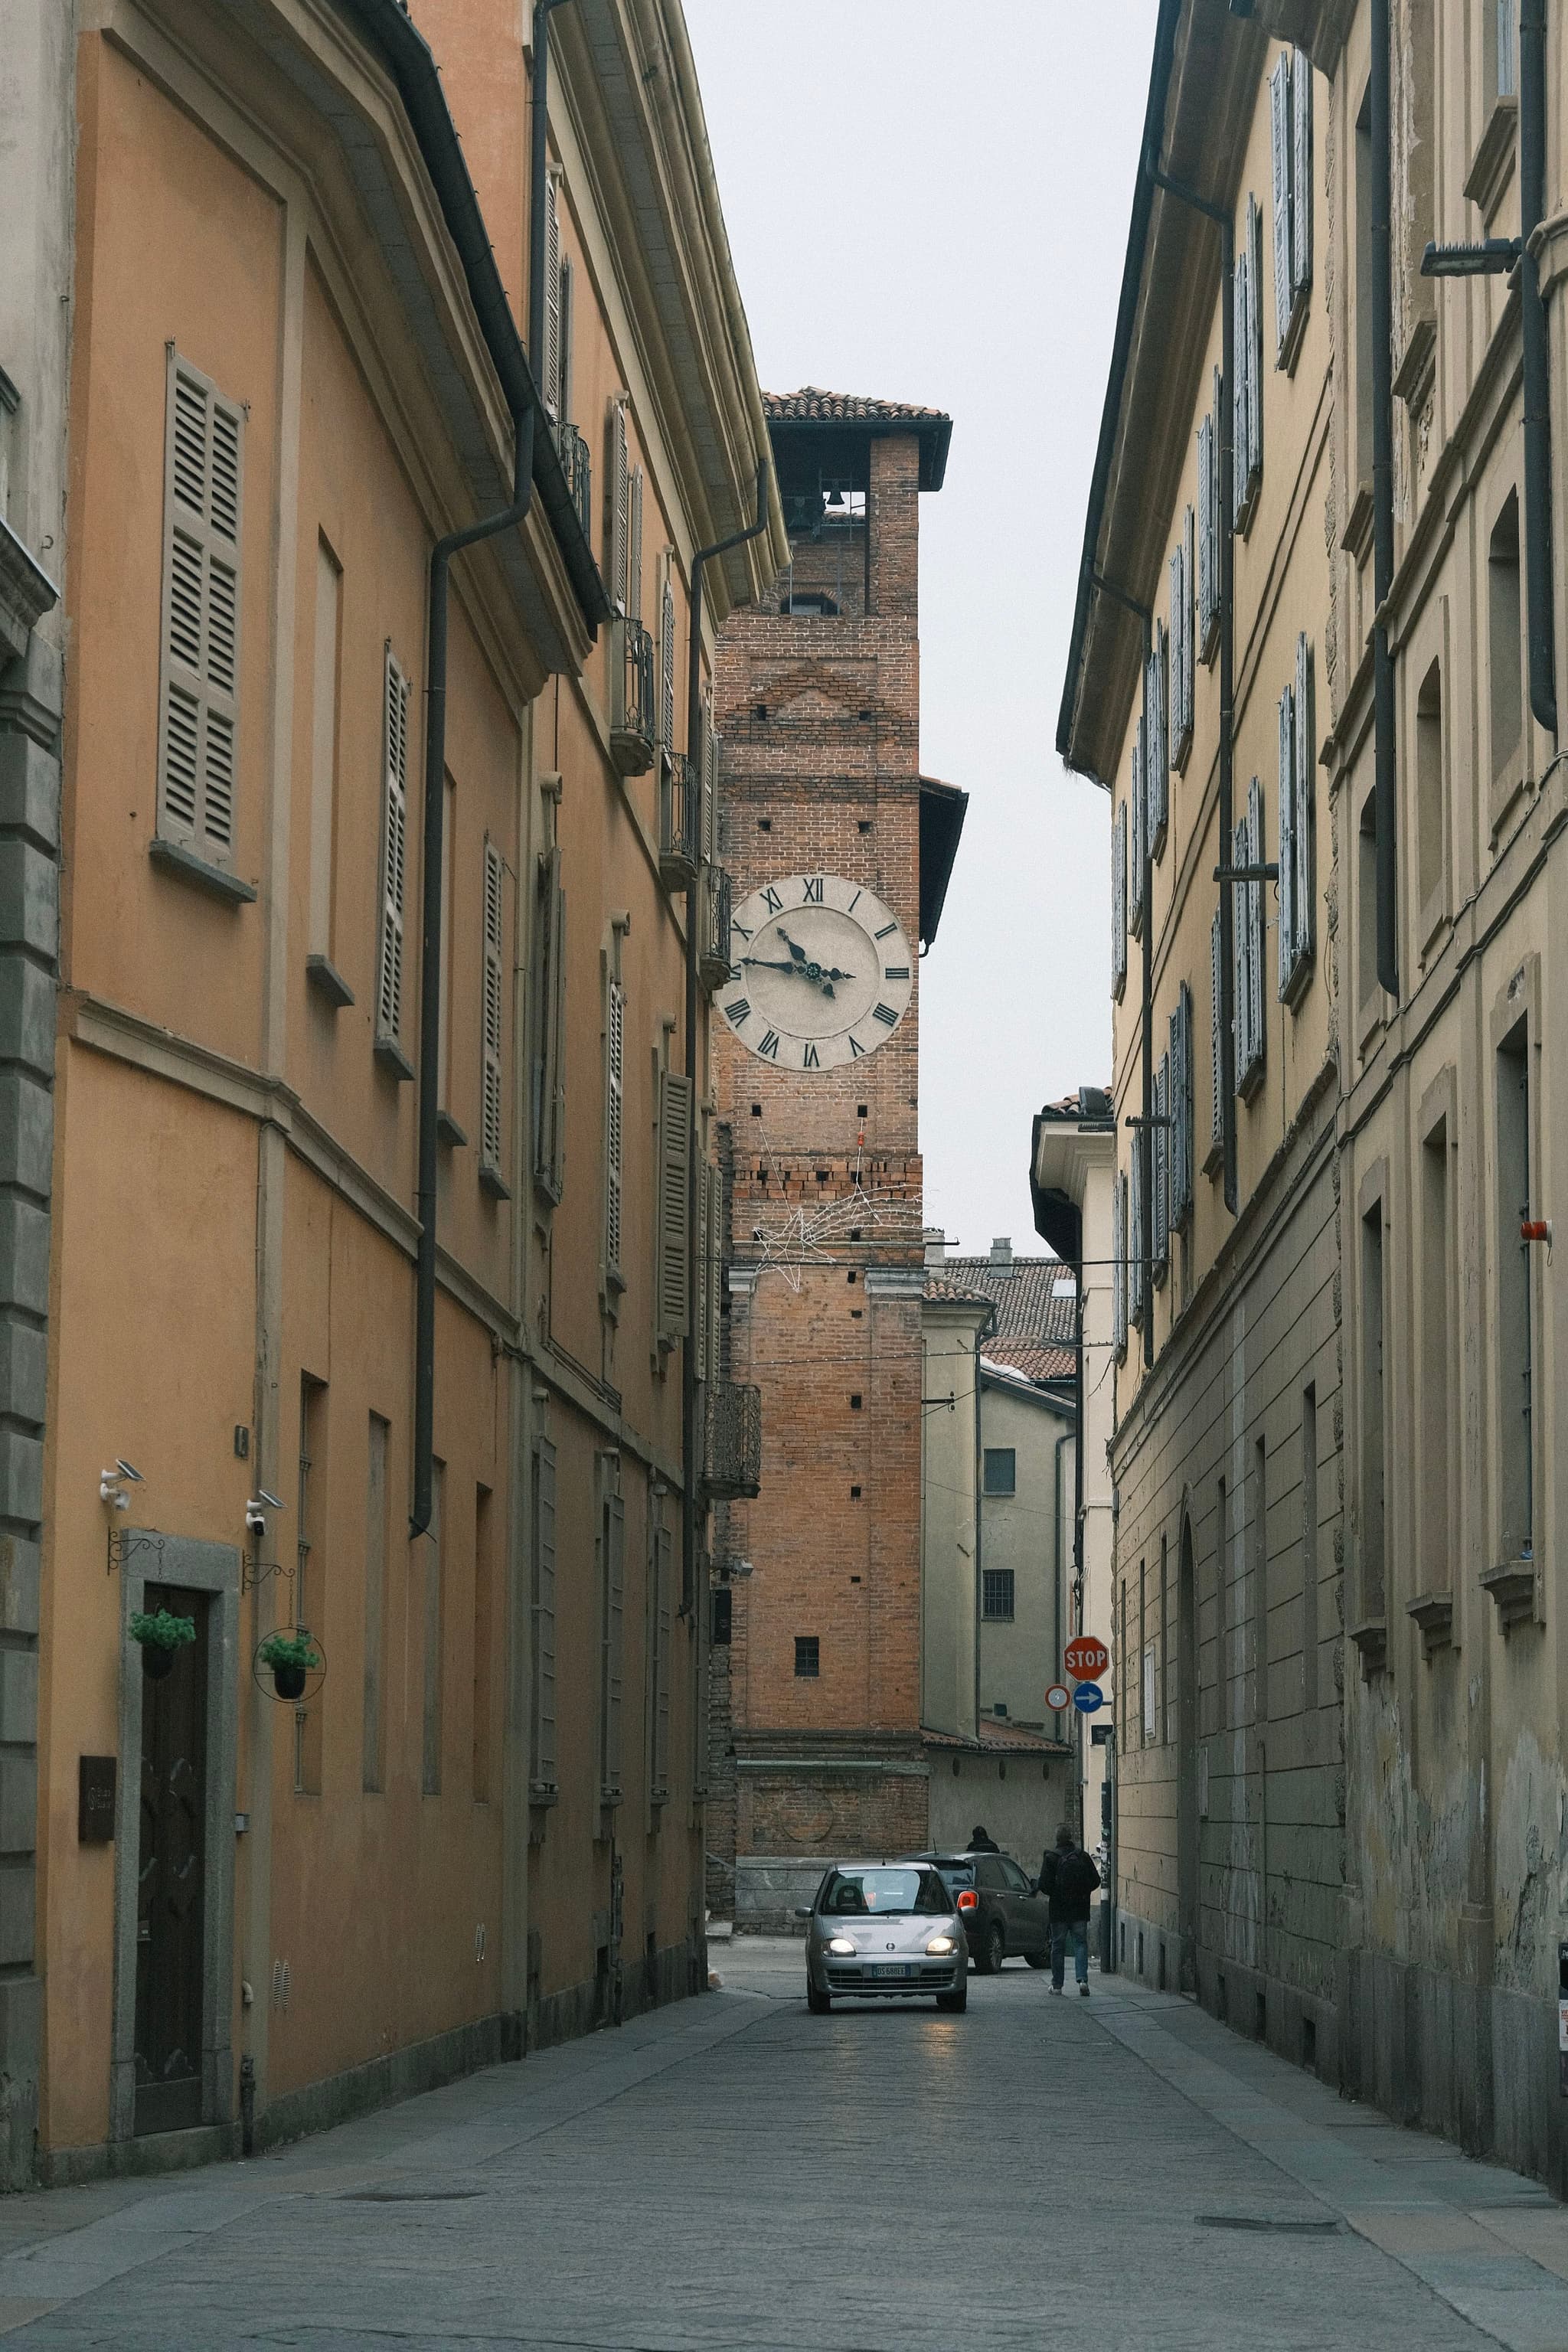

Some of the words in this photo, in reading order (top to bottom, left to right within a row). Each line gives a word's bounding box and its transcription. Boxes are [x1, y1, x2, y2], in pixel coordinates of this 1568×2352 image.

[760, 887, 783, 914] XI
[802, 878, 824, 902] XII
[848, 890, 861, 912] I
[730, 920, 753, 942] X
[874, 922, 898, 940] II
[885, 968, 910, 979] III
[724, 998, 751, 1027] VIII
[872, 1002, 899, 1027] IIII
[757, 1030, 779, 1059] VII
[804, 1043, 819, 1067] VI
[849, 1034, 865, 1057] V
[1067, 1650, 1106, 1668] STOP
